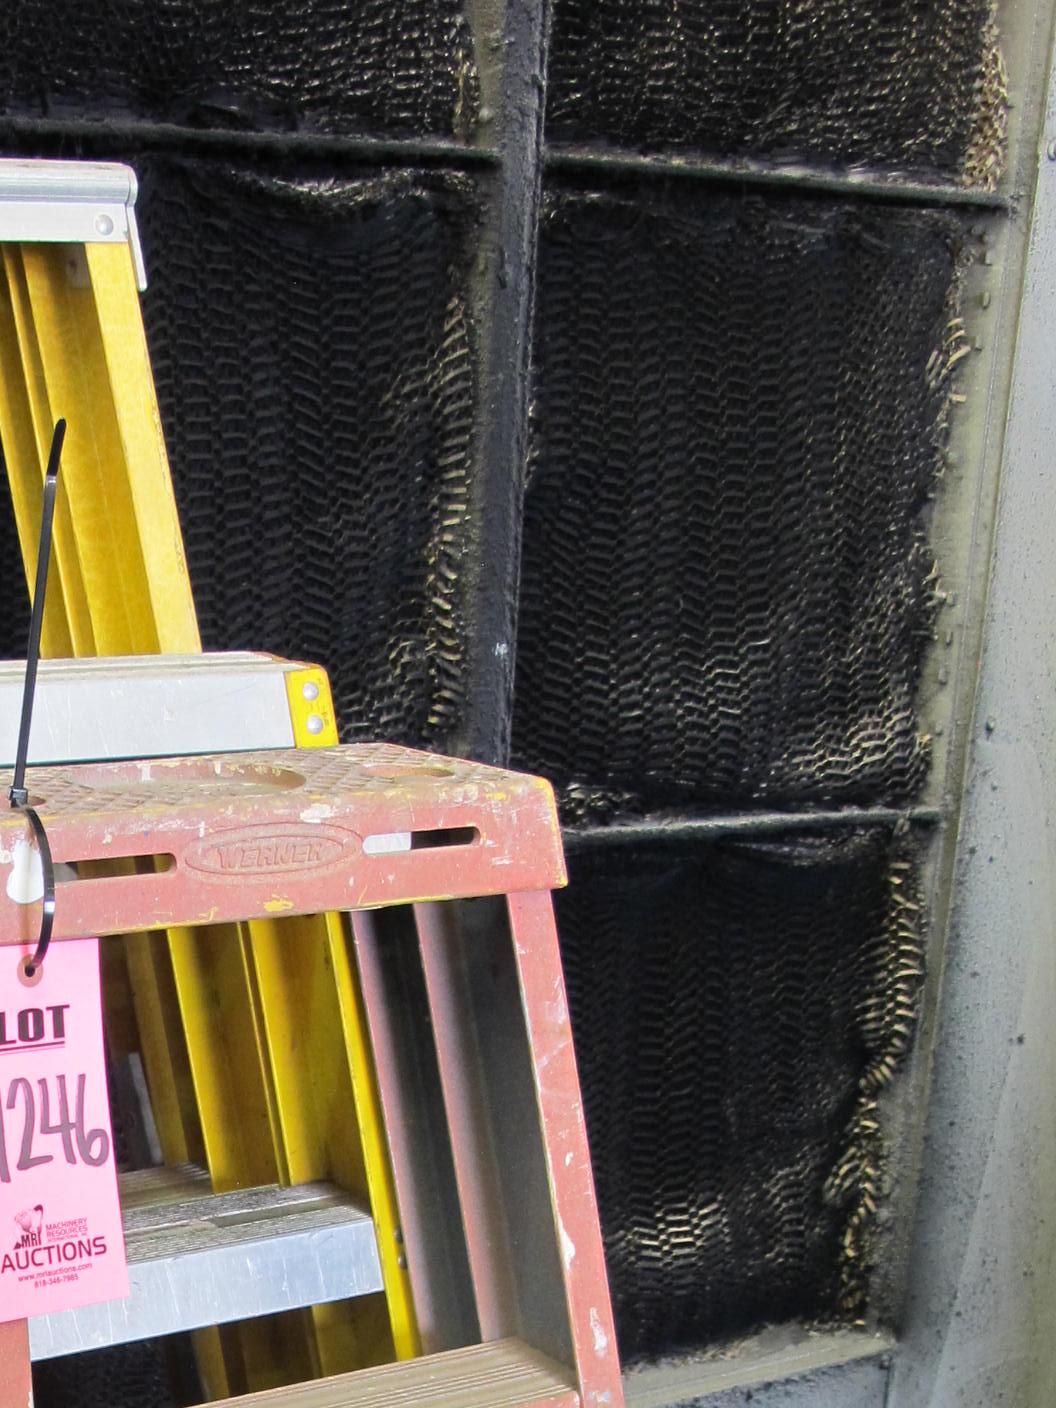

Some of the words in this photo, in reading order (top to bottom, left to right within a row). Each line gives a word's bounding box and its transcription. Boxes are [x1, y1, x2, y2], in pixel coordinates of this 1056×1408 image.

[45, 1218, 87, 1230] MACHINERY
[46, 1225, 88, 1238] RESOURCES
[21, 1231, 43, 1248] MRI
[1, 1236, 107, 1274] AUCTIONS
